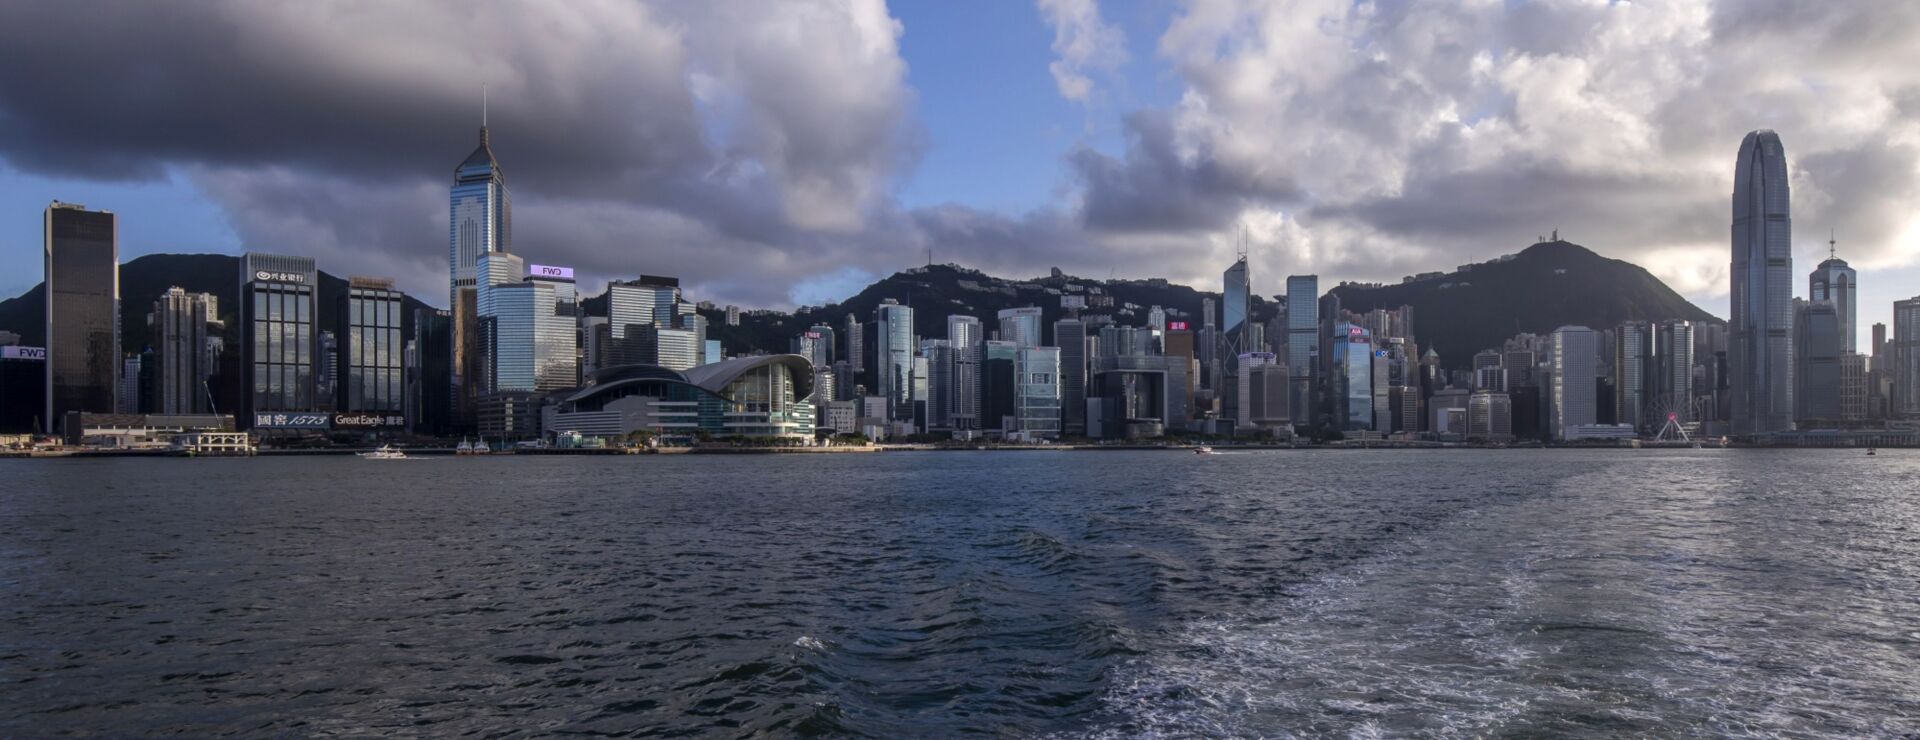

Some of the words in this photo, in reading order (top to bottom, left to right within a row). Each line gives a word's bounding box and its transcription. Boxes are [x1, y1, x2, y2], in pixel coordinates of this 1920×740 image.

[543, 267, 562, 276] FWD
[271, 272, 304, 282] 兴业银行
[289, 415, 327, 425] 1573
[335, 414, 360, 425] Great
[360, 414, 384, 427] Eagle
